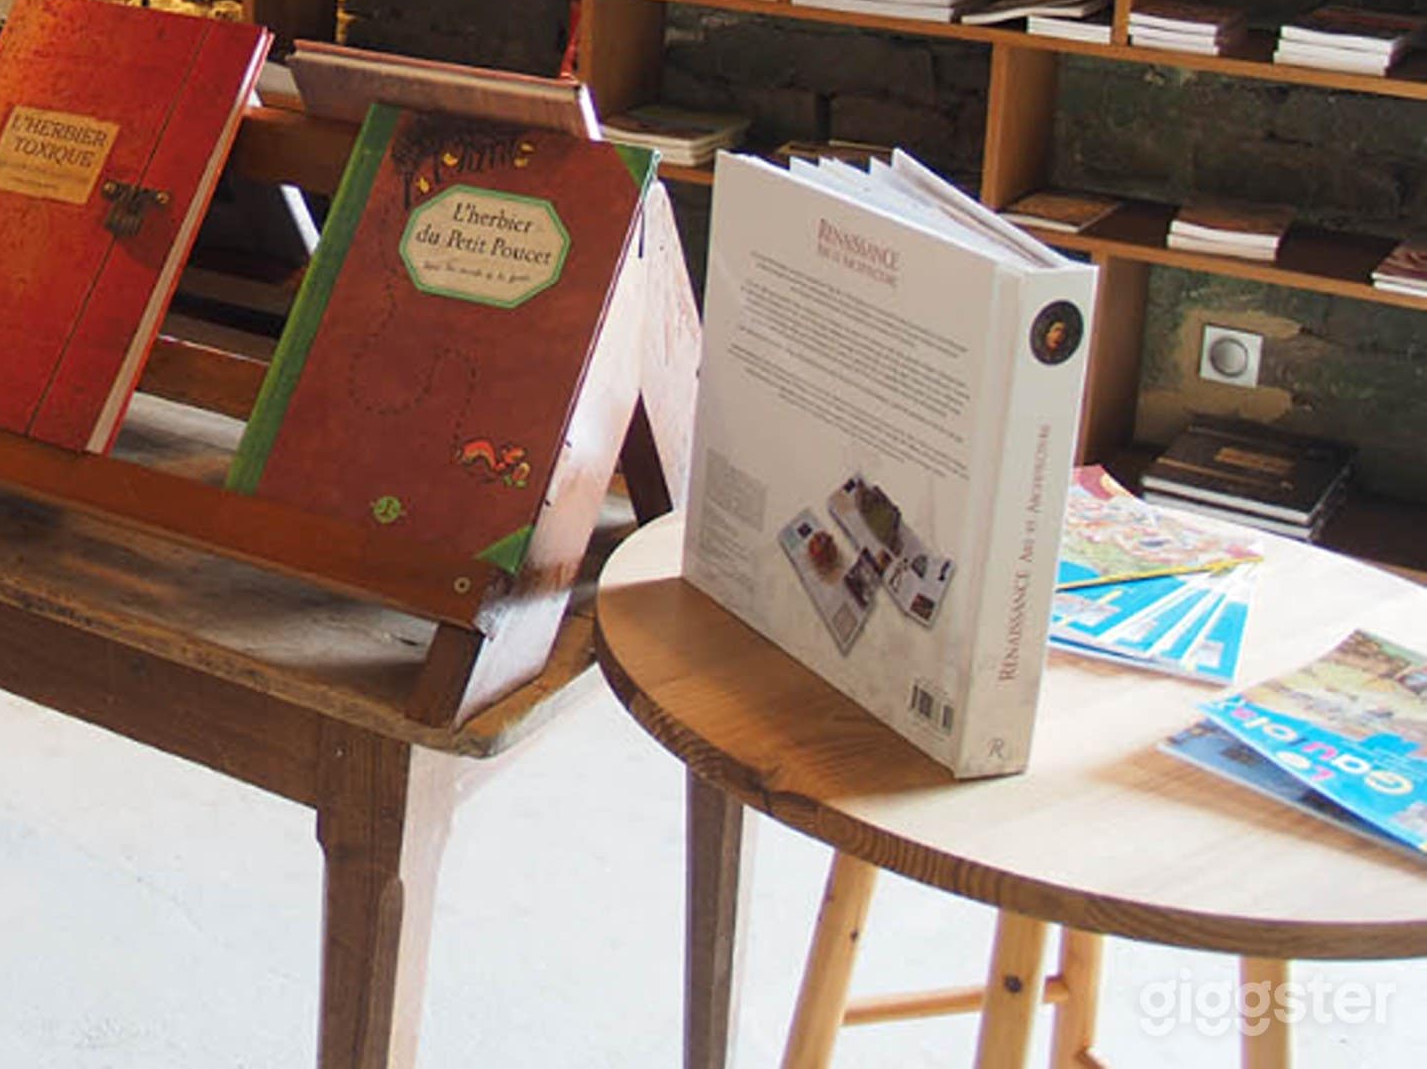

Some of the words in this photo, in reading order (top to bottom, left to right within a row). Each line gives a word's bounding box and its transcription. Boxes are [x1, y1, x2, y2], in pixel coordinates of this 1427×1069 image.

[11, 114, 107, 148] L'HERBIER
[13, 136, 96, 168] TOXIQUE
[452, 202, 535, 234] L'herbier
[415, 223, 440, 246] du
[446, 228, 487, 255] Petit
[490, 236, 553, 266] Poucet
[997, 566, 1032, 682] RENAISSANCE
